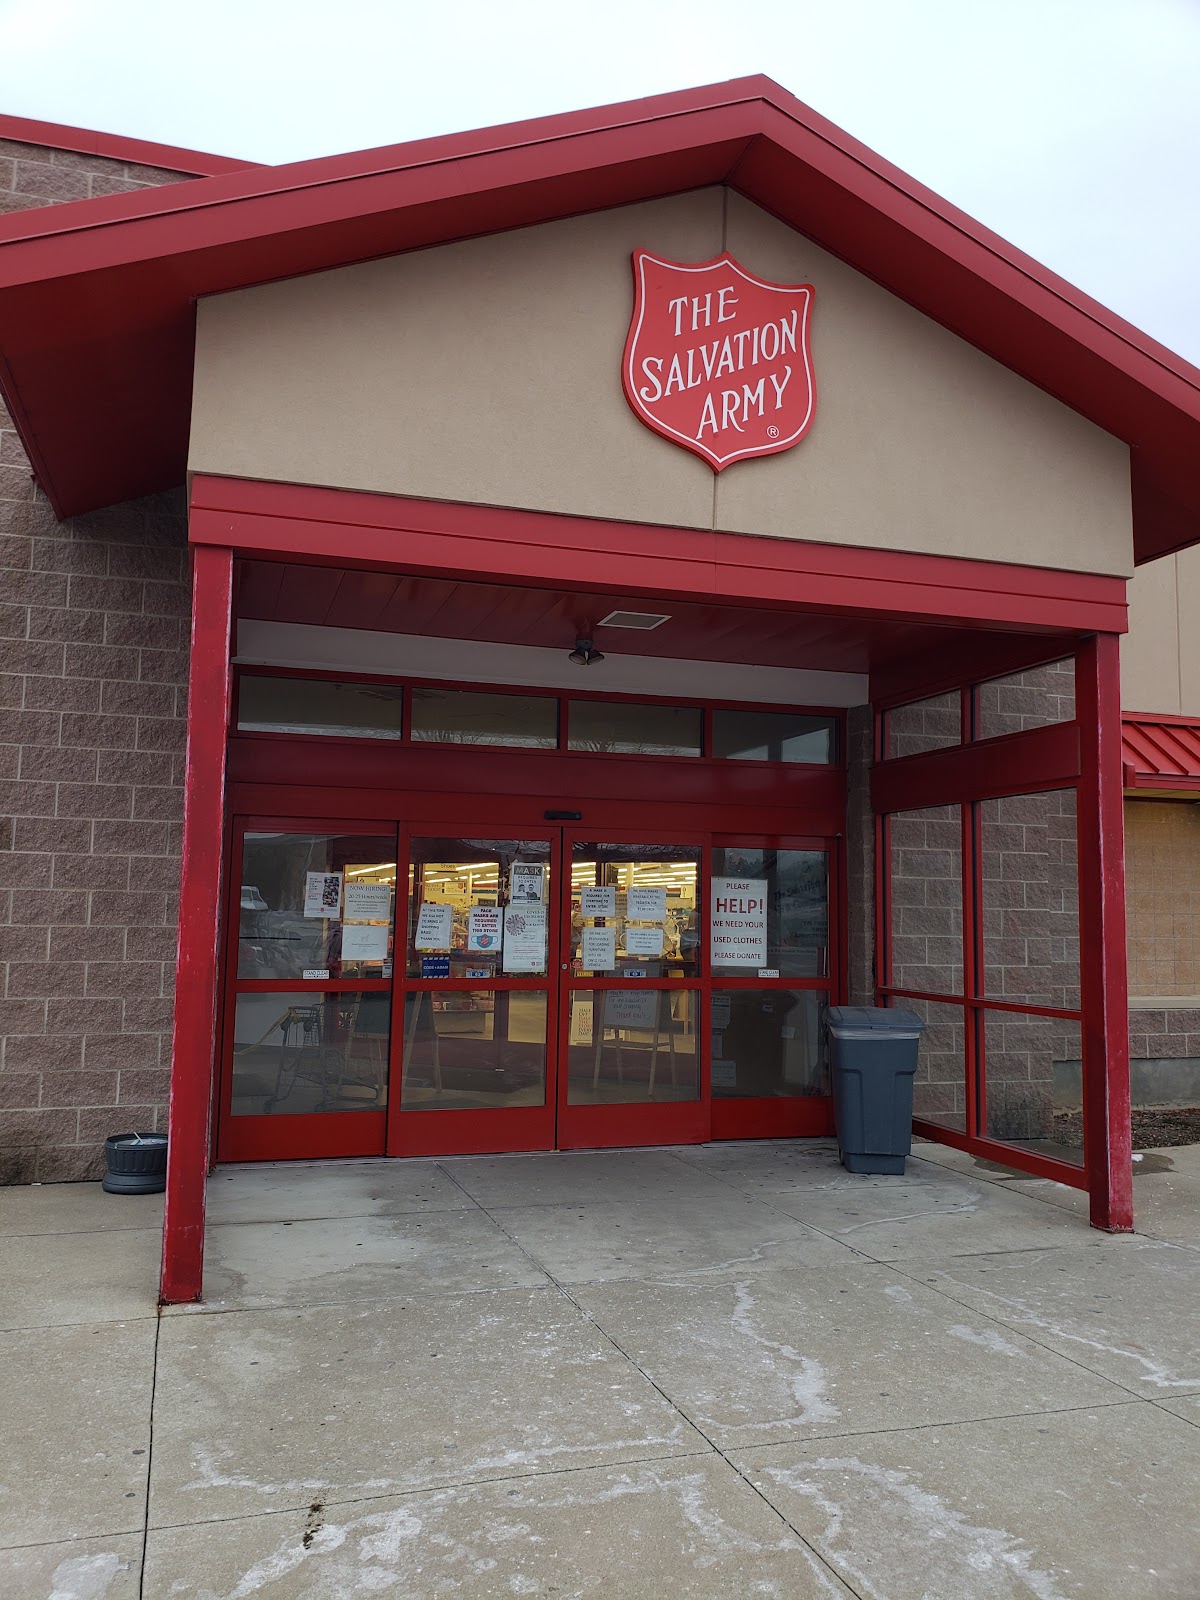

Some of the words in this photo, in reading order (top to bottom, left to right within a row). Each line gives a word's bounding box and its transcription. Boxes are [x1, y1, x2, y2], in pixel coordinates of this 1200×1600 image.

[668, 286, 739, 337] THE
[639, 309, 798, 403] SALVATION
[695, 365, 792, 440] ARMY
[515, 866, 540, 875] MASK
[726, 882, 750, 890] PLEASE
[716, 897, 763, 915] HELP!
[724, 920, 744, 928] NEED
[744, 921, 764, 929] YOUR
[713, 936, 731, 944] USED
[732, 936, 763, 945] CLOTHES
[736, 952, 762, 960] DONATE
